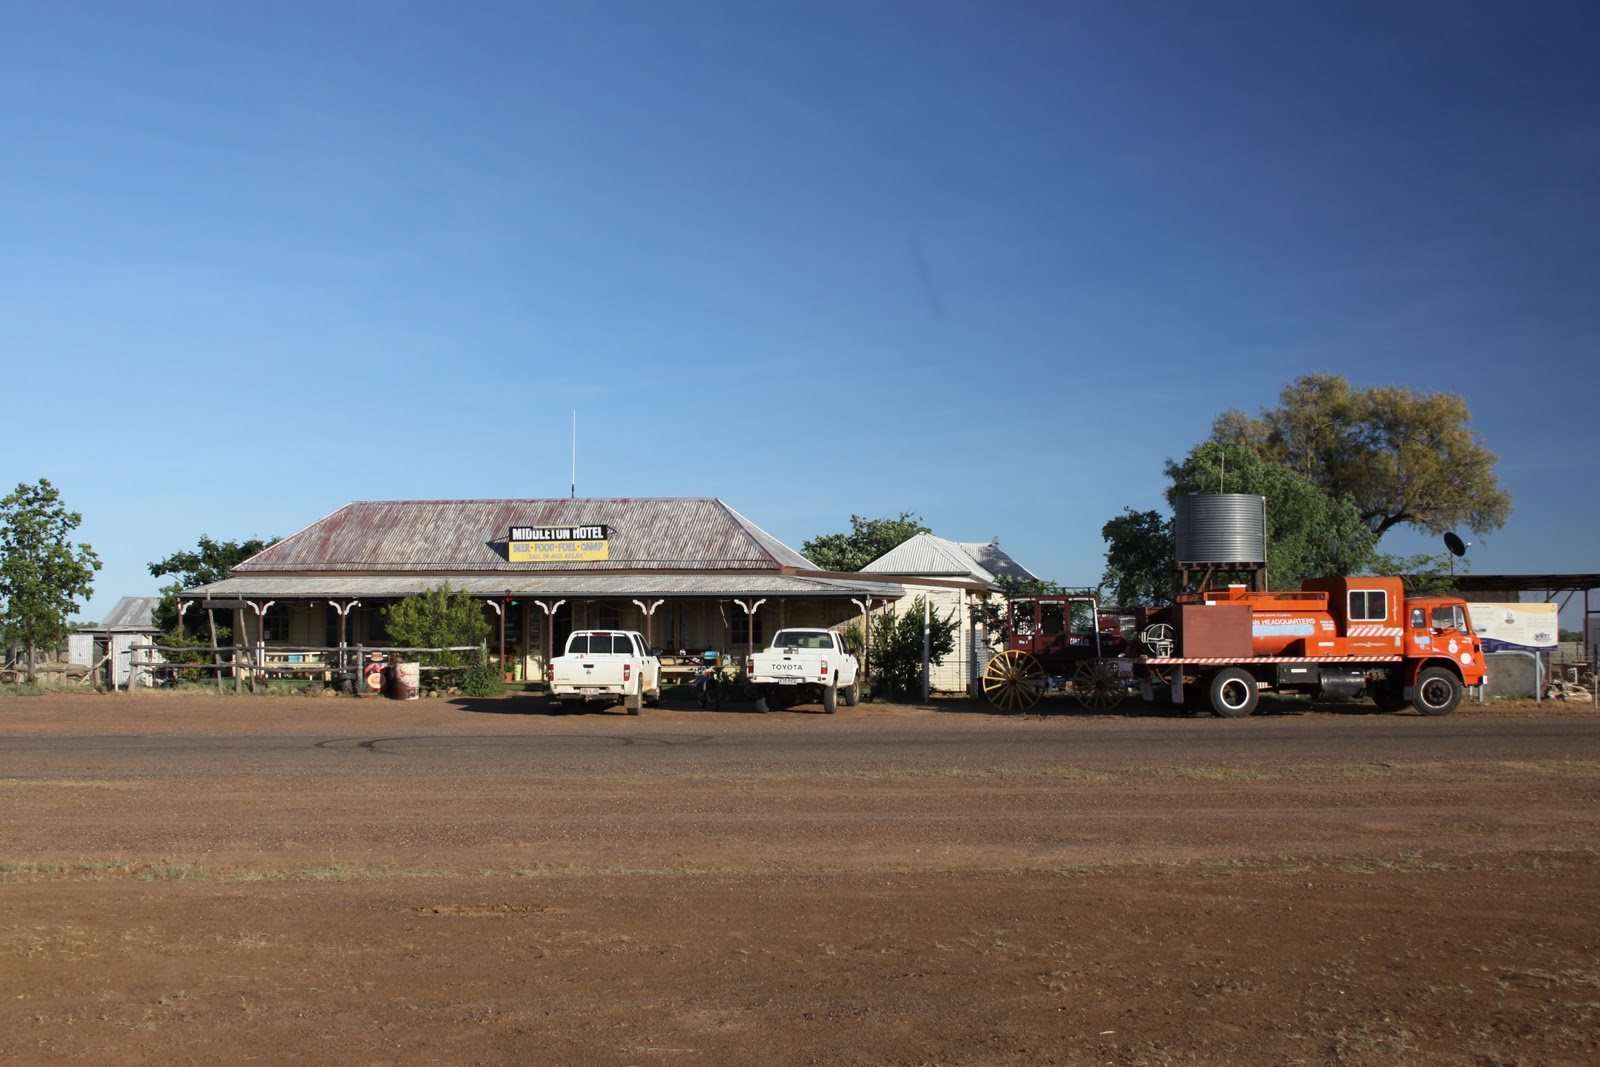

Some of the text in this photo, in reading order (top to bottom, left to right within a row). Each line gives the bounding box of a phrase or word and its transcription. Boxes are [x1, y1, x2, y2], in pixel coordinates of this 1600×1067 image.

[573, 527, 604, 539] HOTEL
[513, 542, 603, 552] BEER FOOD FUEL CAMP
[1261, 618, 1315, 626] HEADQUARTERS
